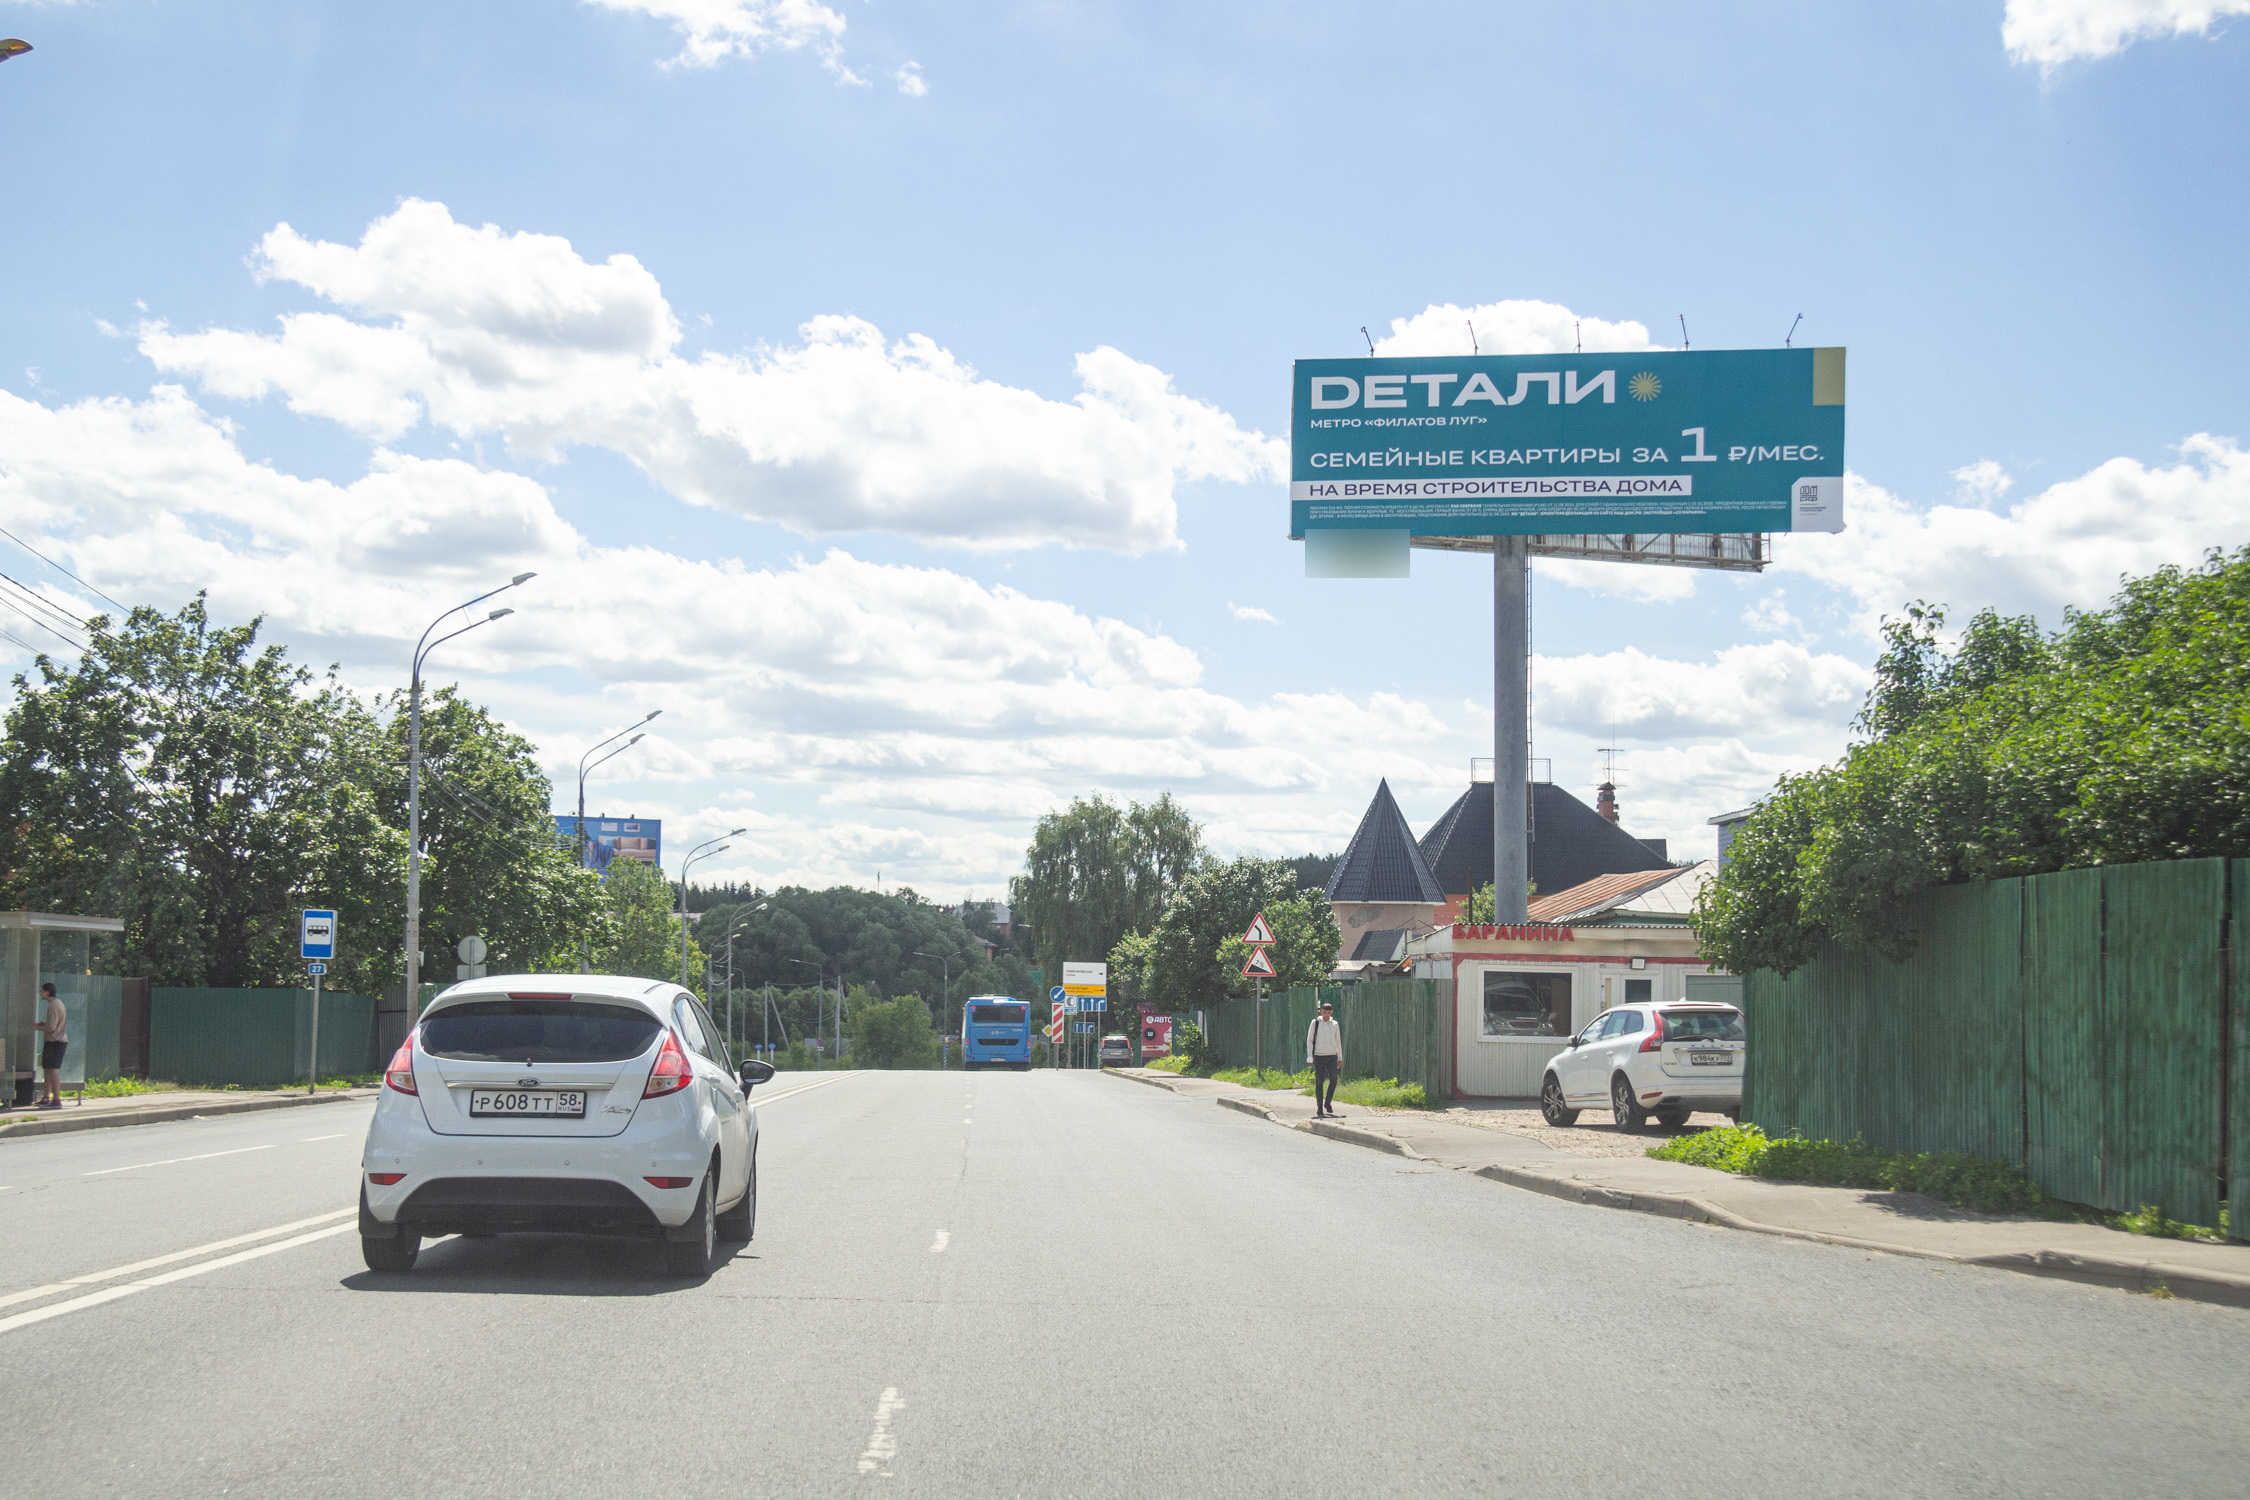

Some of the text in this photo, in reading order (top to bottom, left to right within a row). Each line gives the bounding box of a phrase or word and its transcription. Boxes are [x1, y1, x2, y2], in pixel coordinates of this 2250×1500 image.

[1310, 416, 1488, 429] МЕТРО «ФИЛАТОВ ЛУГ»
[1310, 447, 1464, 468] СЕМЕЙНЫЕ
[1471, 448, 1620, 465] КВАРТИРЫ
[1632, 447, 1669, 463] ЗА
[1681, 427, 1717, 462] 1
[1309, 479, 1683, 496] НА ВРЕМЯ СТРОИТЕЛЬСТВА ДОМА
[1452, 924, 1575, 941] БАРАНИНА
[559, 1094, 578, 1106] 58
